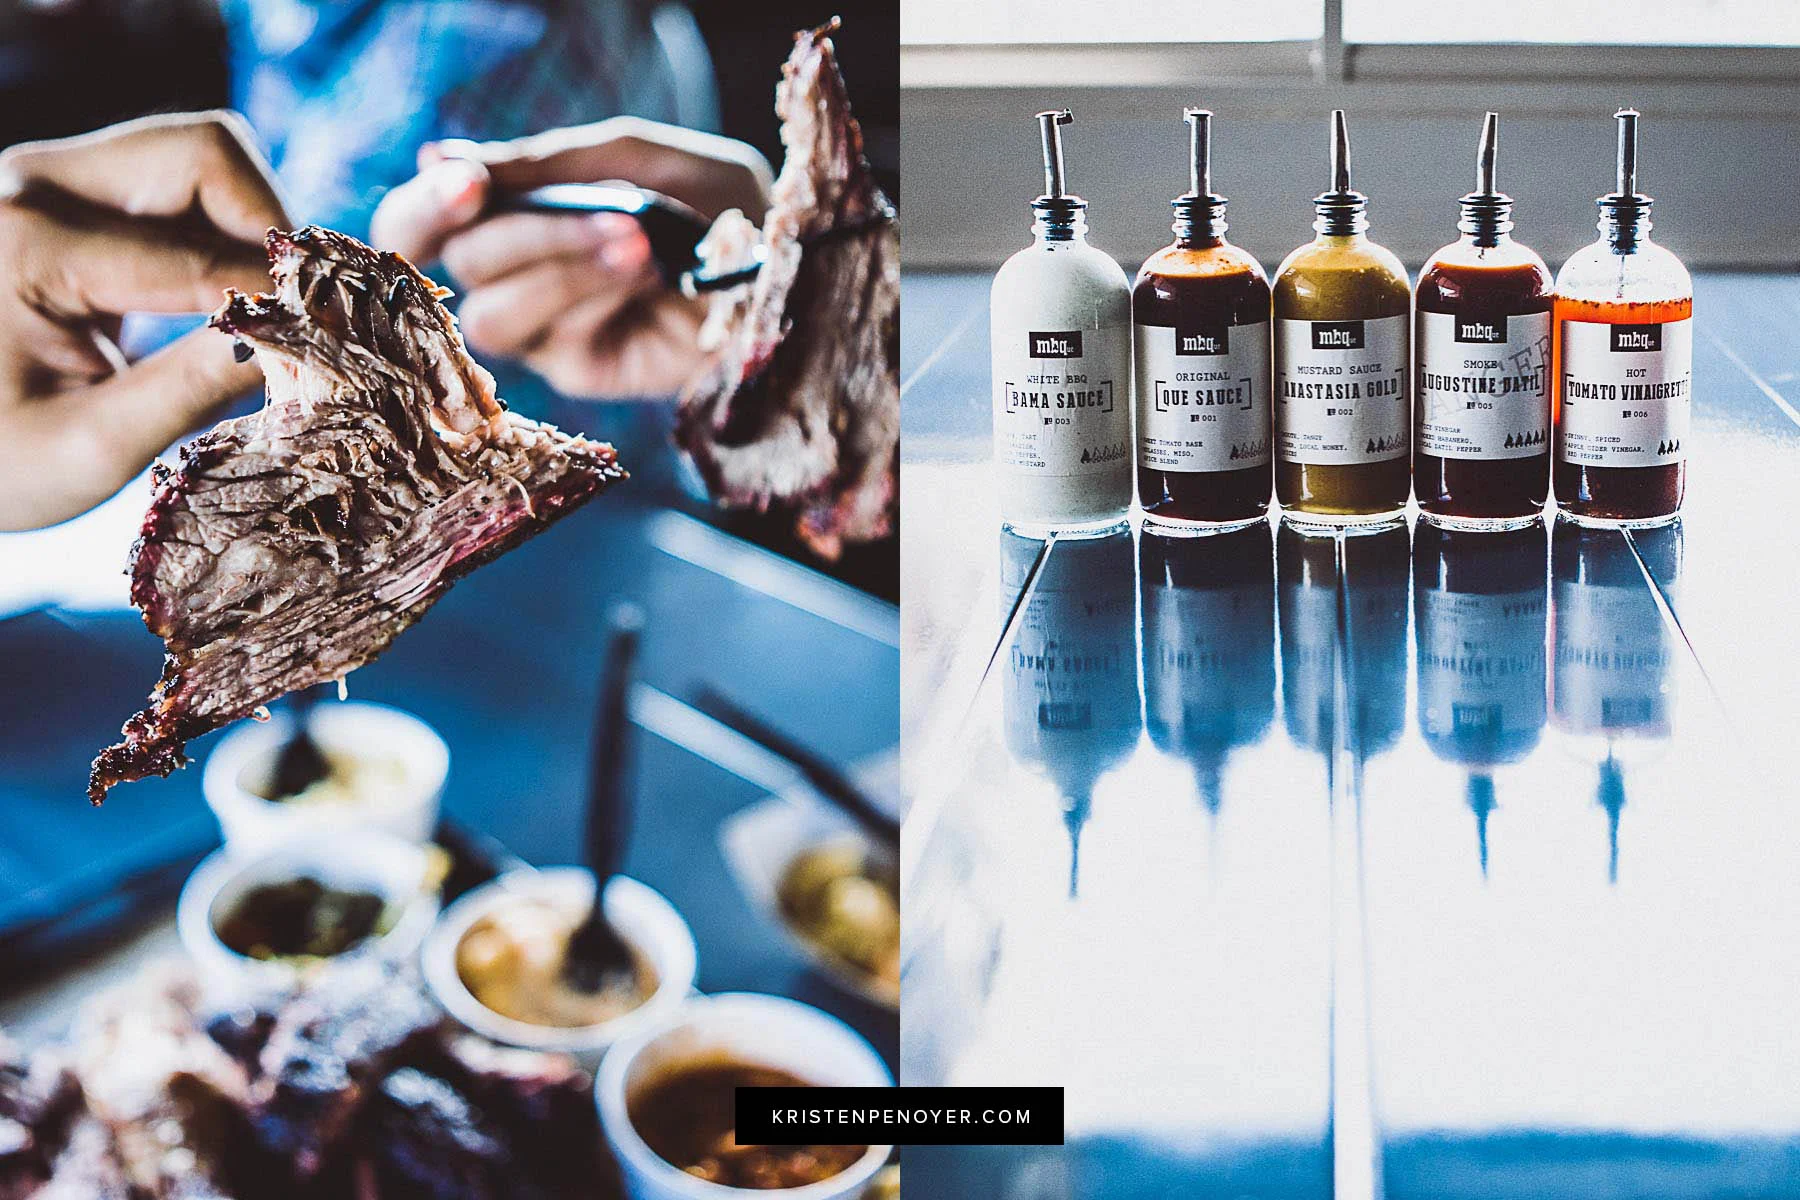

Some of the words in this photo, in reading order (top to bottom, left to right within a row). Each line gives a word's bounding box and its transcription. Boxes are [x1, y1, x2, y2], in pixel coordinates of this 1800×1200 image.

[1297, 366, 1343, 375] MUSTARD
[1350, 364, 1382, 374] SAUCE
[1464, 360, 1498, 369] SMOKE
[1176, 372, 1230, 382] ORIGINAL
[1626, 369, 1647, 378] HOT
[1027, 376, 1060, 384] WHITE
[1067, 375, 1088, 384] BBQ
[1422, 373, 1496, 394] AUGUSTINE
[1285, 381, 1360, 400] ANASTASIA
[1367, 378, 1397, 398] GOLD
[1569, 381, 1616, 400] TOMATO
[1013, 392, 1050, 409] BAMA
[1057, 390, 1104, 409] SAUCE
[1163, 390, 1189, 406] QUE
[1196, 388, 1243, 406] SAUCE
[1595, 435, 1621, 443] SPICED
[1567, 450, 1577, 458] RED
[1580, 452, 1603, 460] PEPPER
